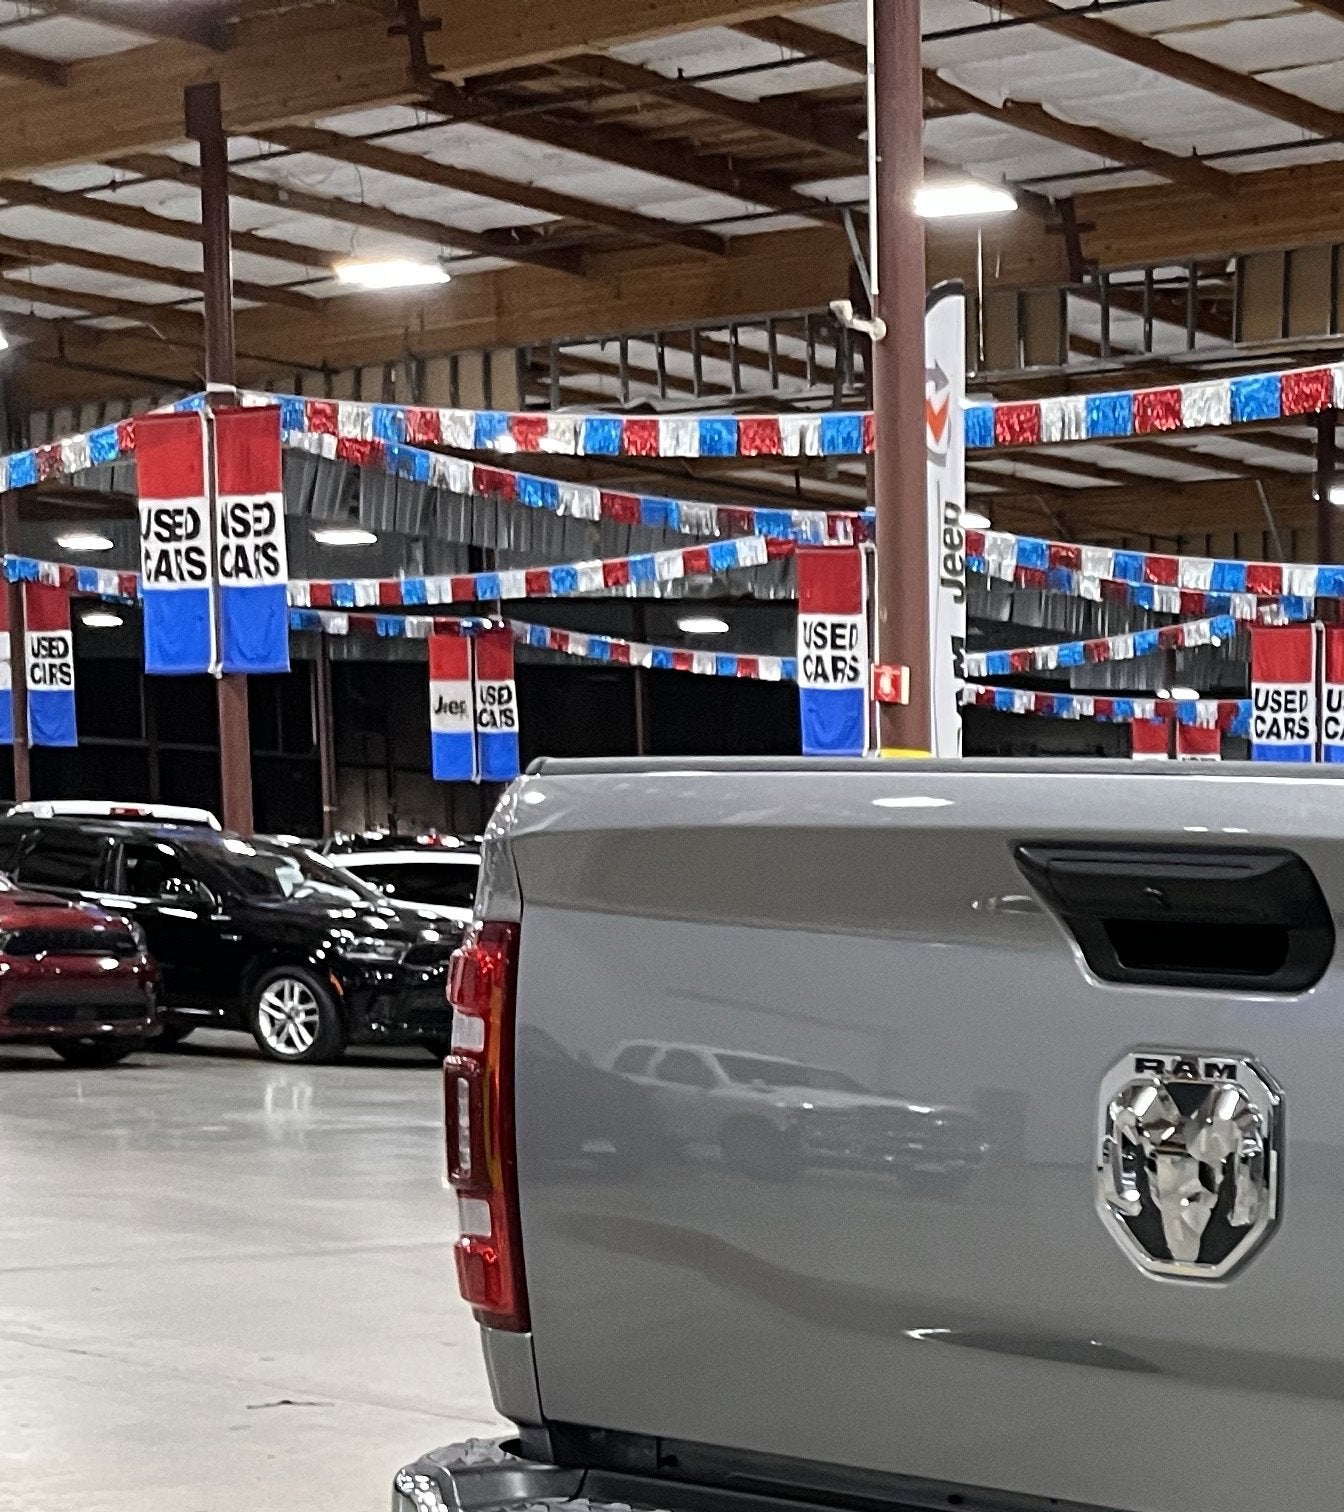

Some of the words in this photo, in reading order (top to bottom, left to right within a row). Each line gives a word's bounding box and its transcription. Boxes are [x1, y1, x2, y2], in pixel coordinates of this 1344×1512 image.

[30, 635, 69, 659] USED
[803, 621, 859, 651] USED
[803, 654, 860, 684] CARS
[1254, 688, 1309, 713] USED
[1254, 715, 1310, 740] CARS
[1135, 1057, 1237, 1080] RAM
